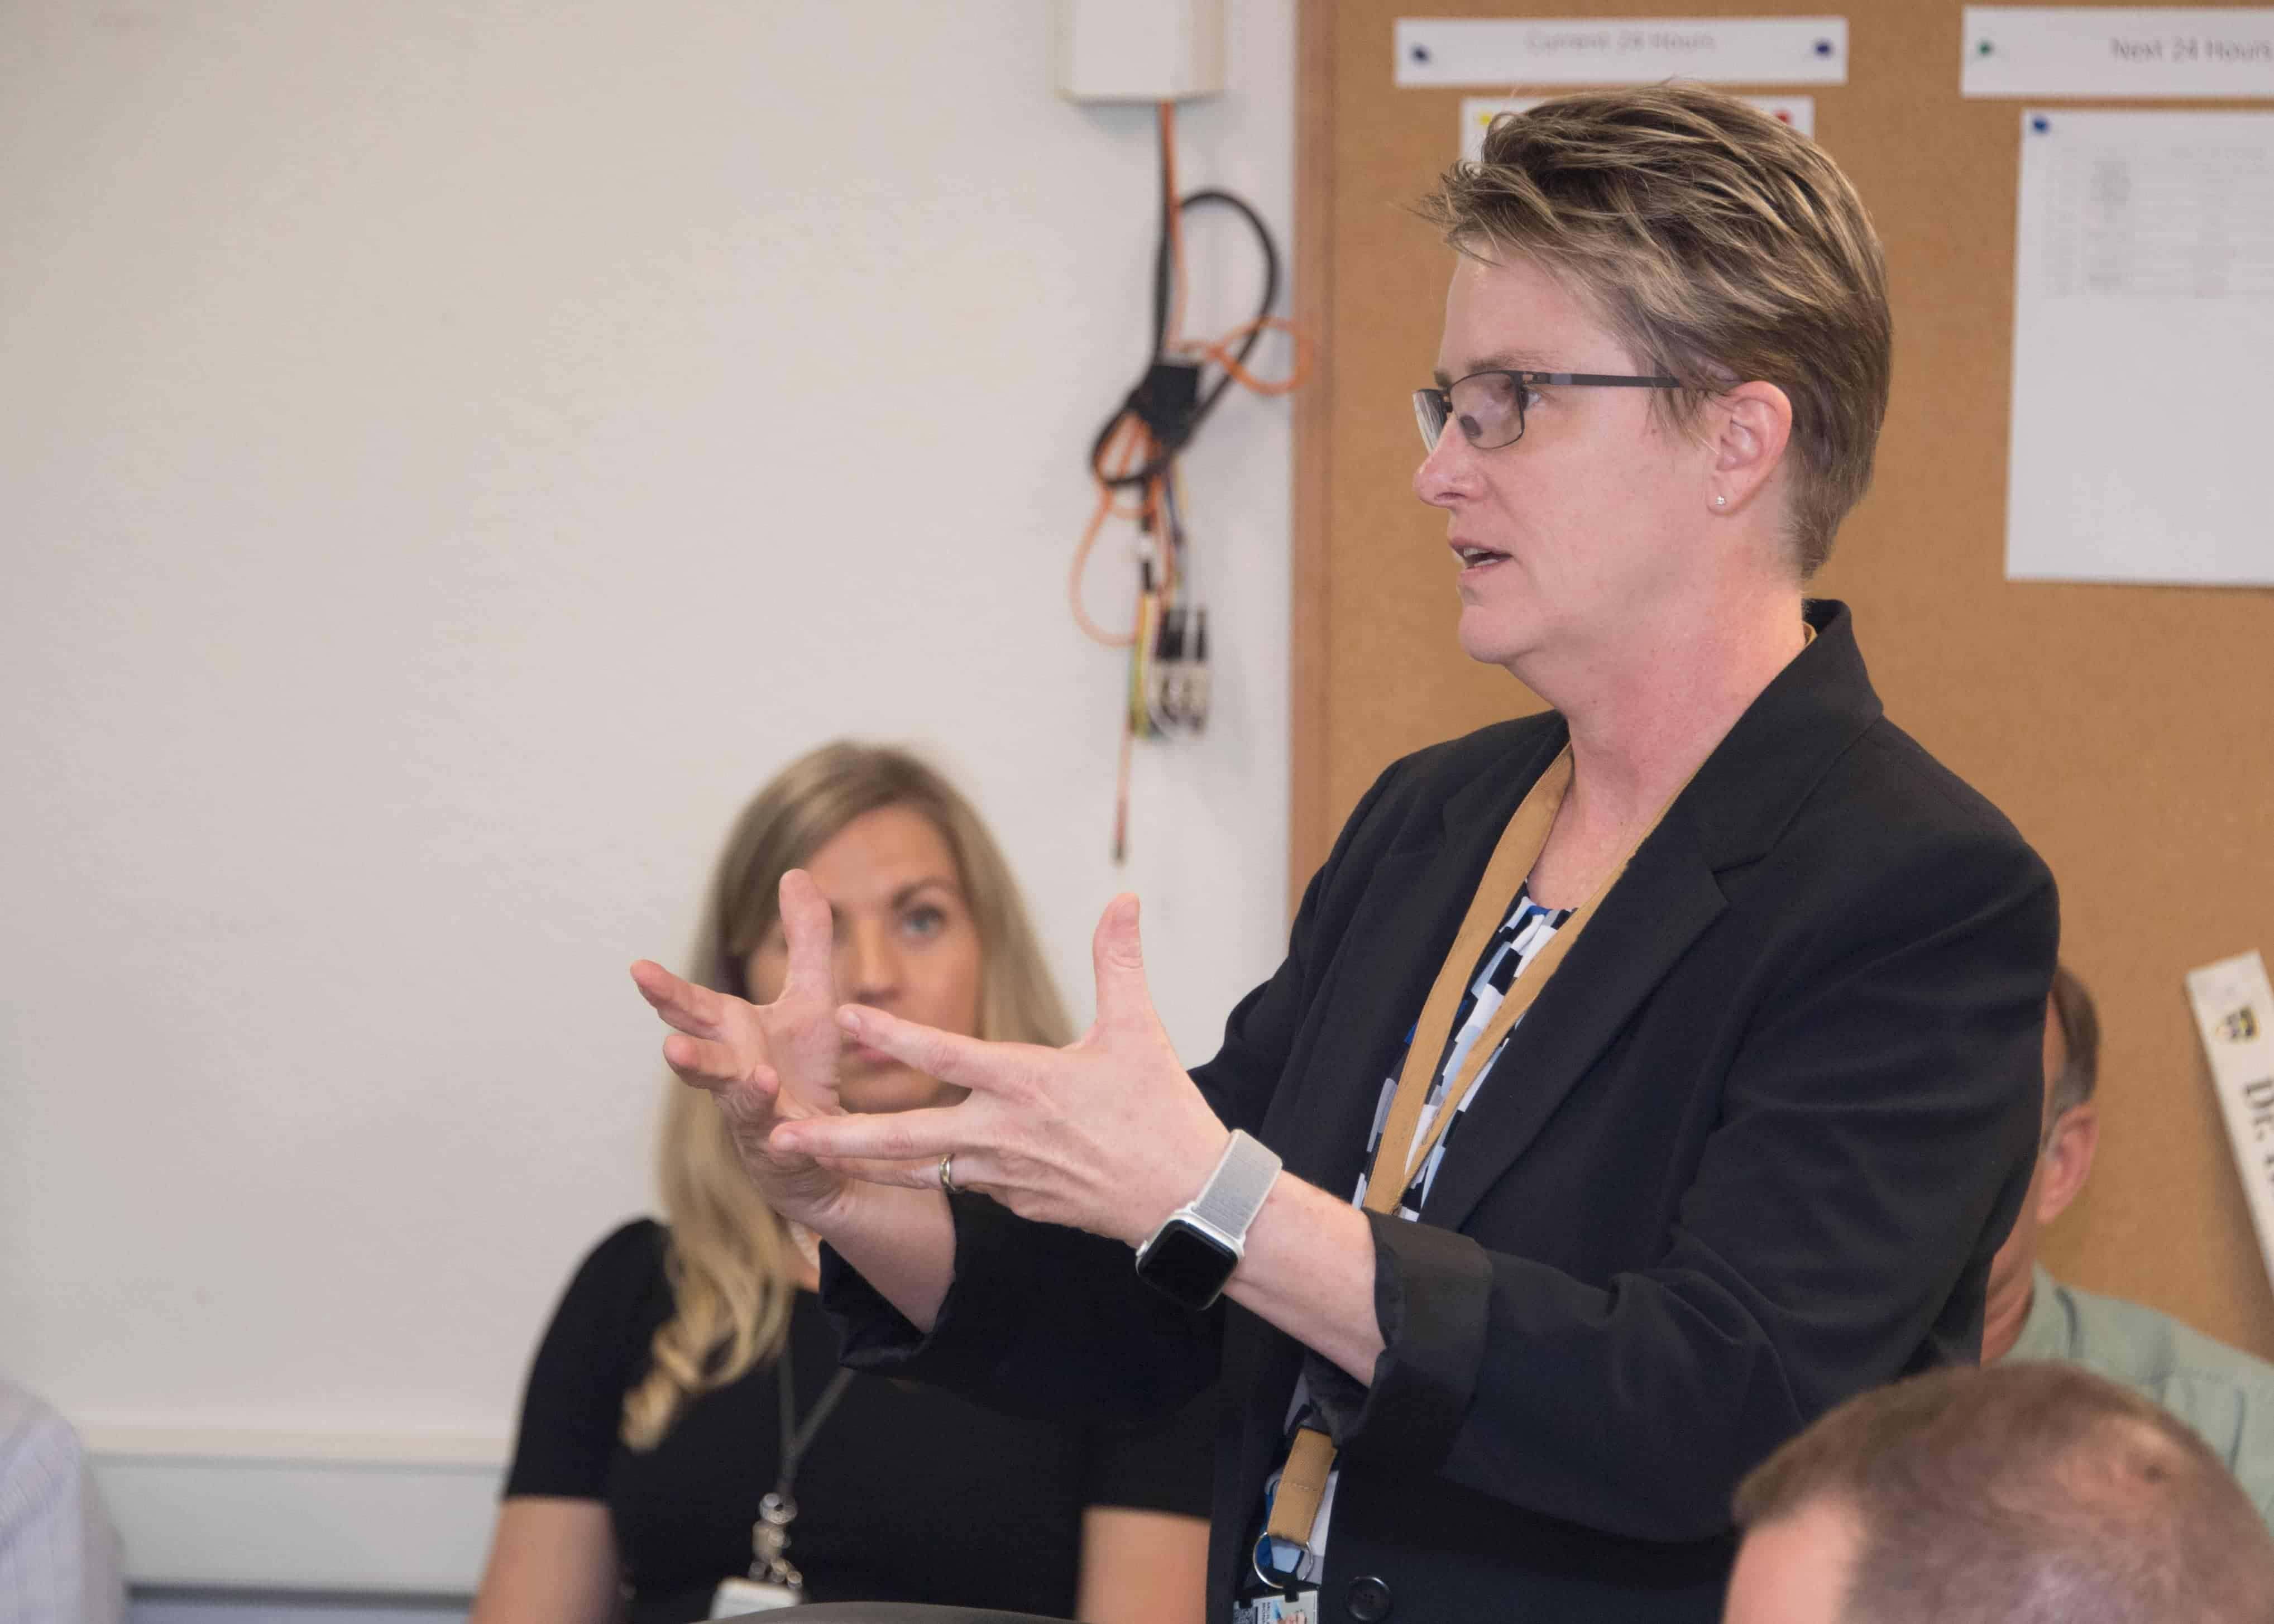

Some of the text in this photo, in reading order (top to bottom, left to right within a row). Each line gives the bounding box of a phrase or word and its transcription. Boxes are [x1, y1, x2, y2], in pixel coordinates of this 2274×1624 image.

[1526, 32, 1608, 53] Current
[1653, 31, 1716, 50] Hours
[2112, 38, 2162, 60] Next
[2172, 38, 2198, 61] 24
